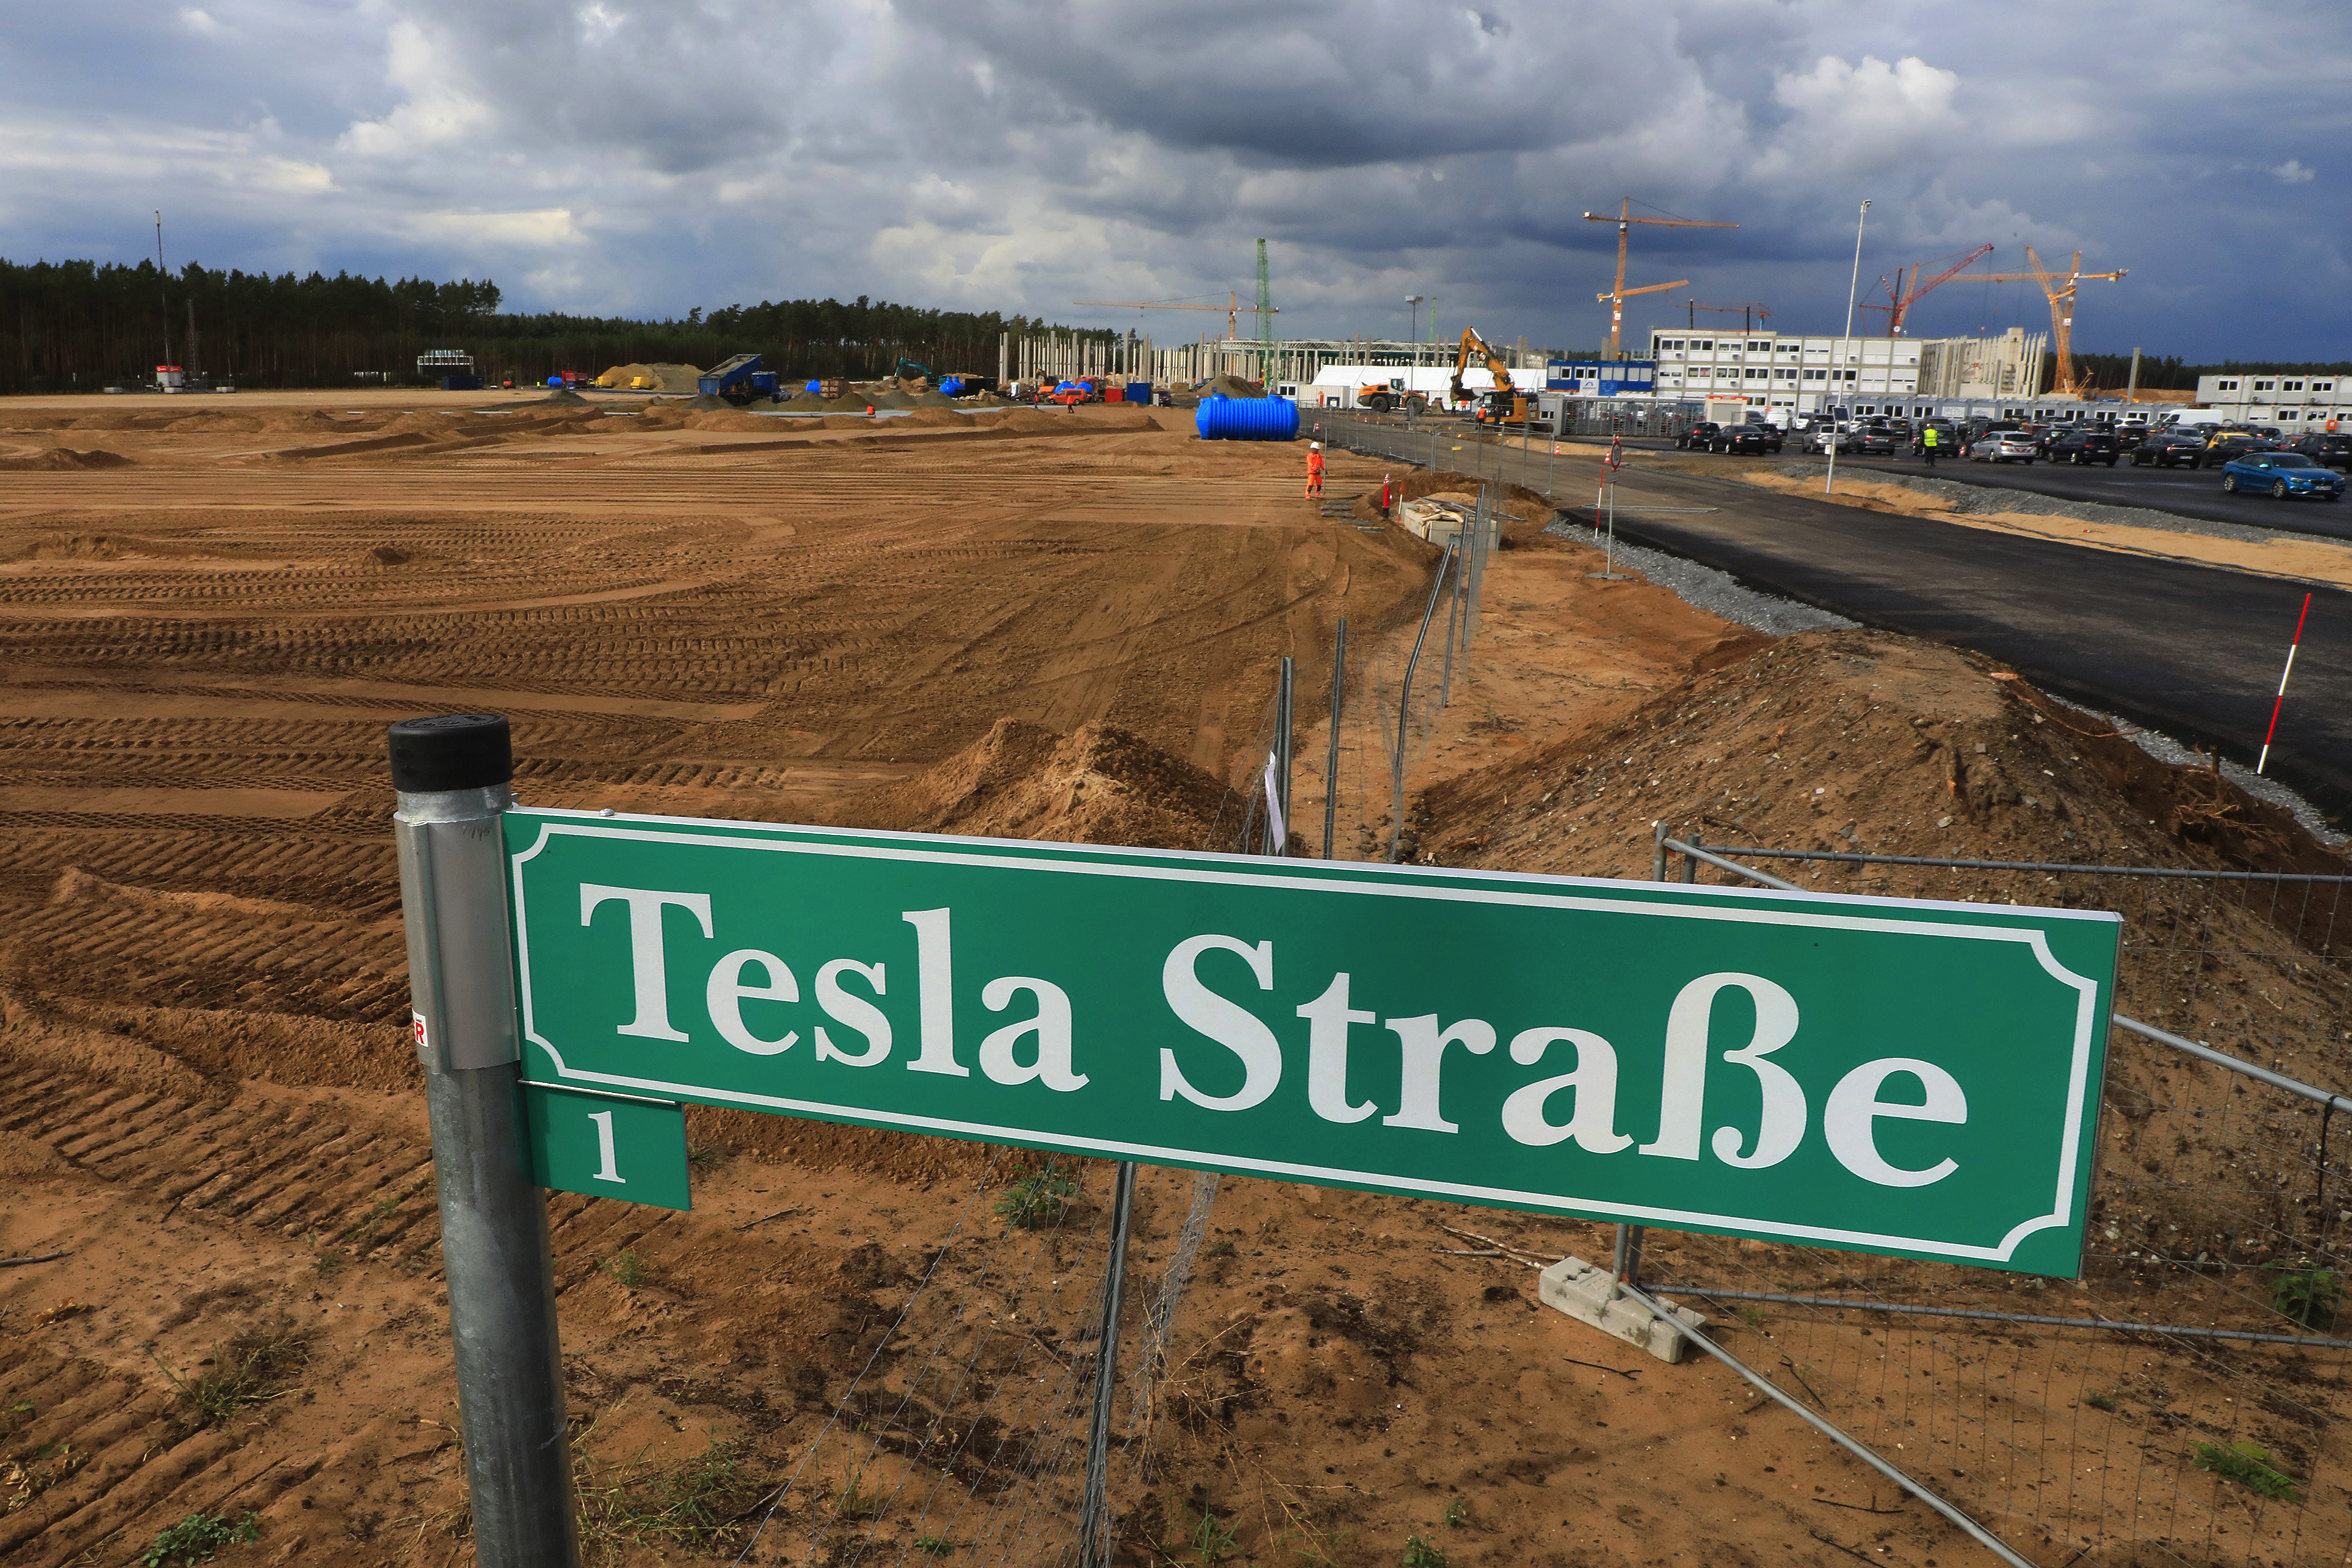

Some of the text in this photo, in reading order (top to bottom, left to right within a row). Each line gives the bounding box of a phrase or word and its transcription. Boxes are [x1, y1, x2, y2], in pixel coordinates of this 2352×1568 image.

[580, 883, 1967, 1187] Tesla Straße
[589, 1111, 626, 1183] 1
